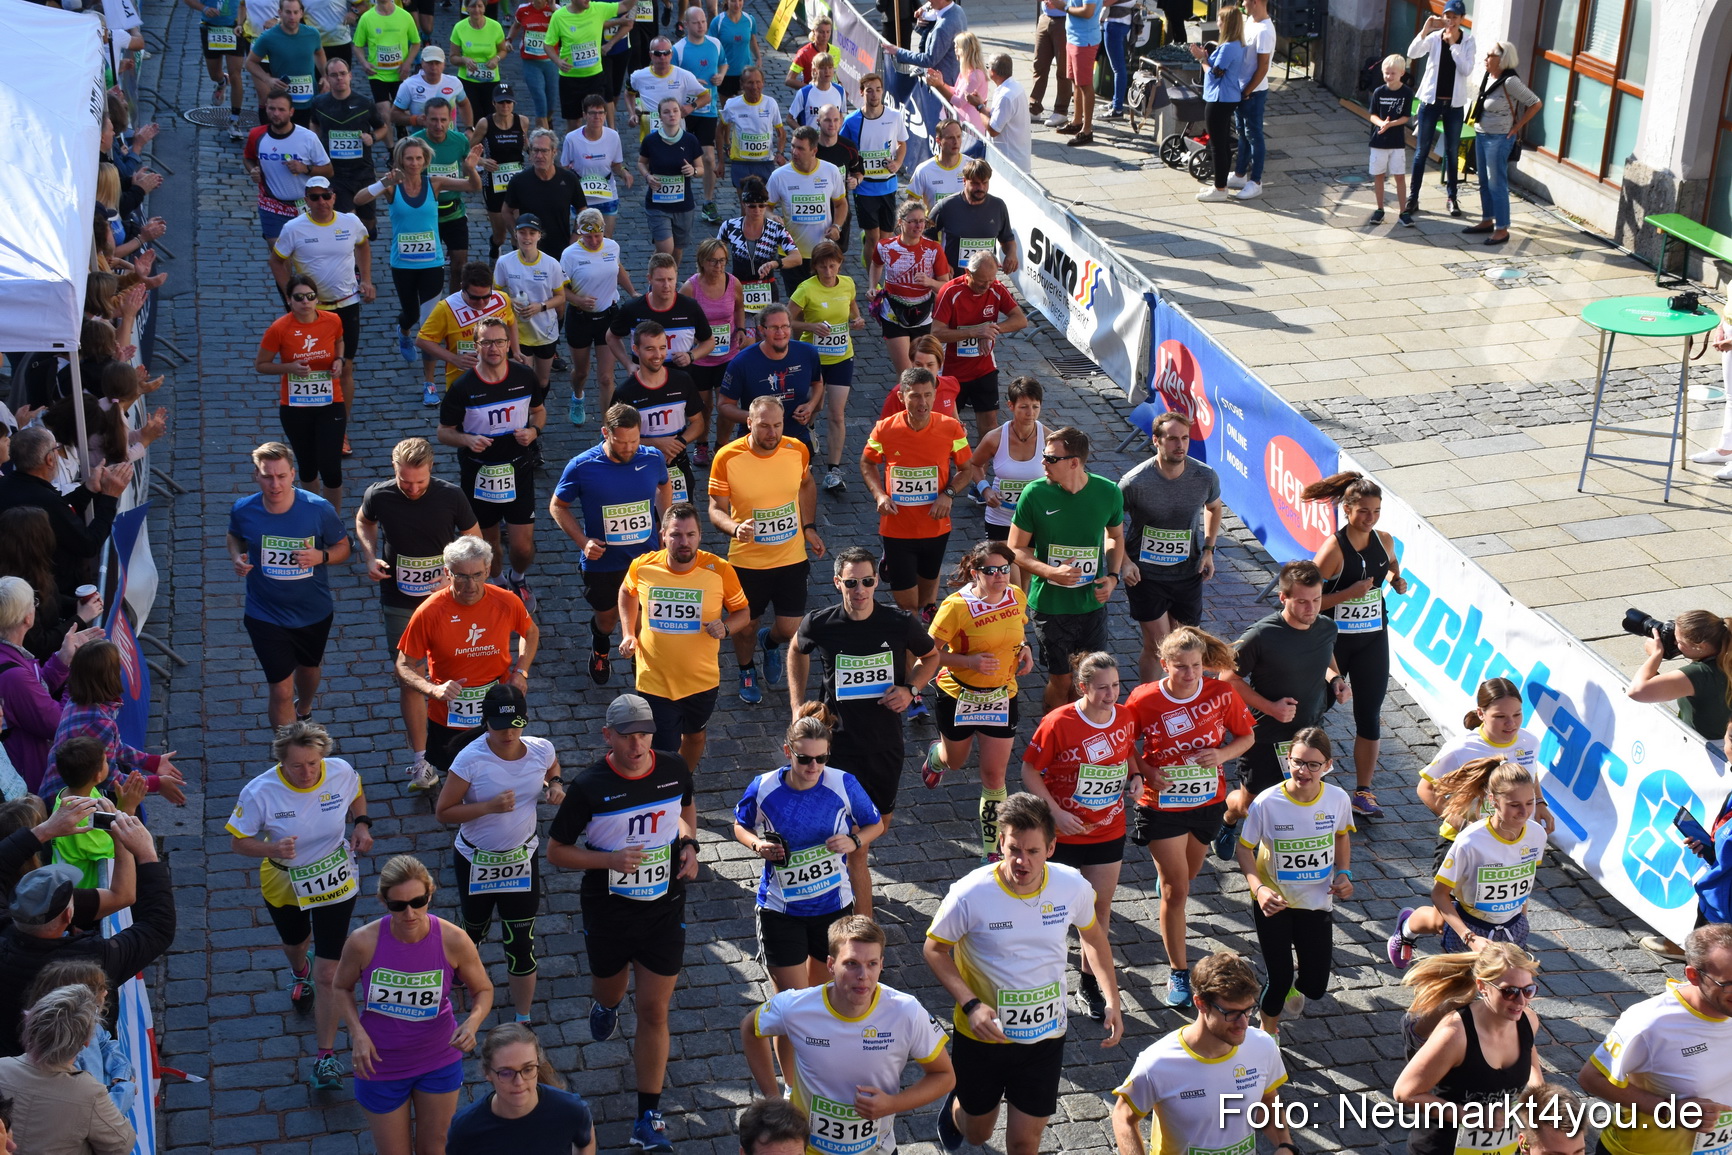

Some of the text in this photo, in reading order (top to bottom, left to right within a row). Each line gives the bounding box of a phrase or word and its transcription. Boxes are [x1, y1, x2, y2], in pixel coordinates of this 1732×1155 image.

[212, 35, 233, 43] 1353
[379, 51, 400, 60] 5059
[575, 51, 597, 60] 2233
[333, 139, 360, 149] 2522
[744, 142, 767, 151] 1005
[583, 182, 608, 191] 1022
[656, 184, 681, 194] 2072
[793, 194, 823, 202] BOCK
[795, 204, 823, 214] 2290
[402, 242, 432, 253] 2722
[963, 239, 994, 247] BOCK
[1028, 227, 1078, 297] swn
[817, 334, 847, 346] 2208
[817, 346, 846, 354] GERLINDE
[294, 383, 328, 395] 2134
[1156, 345, 1210, 427] Hervis
[296, 396, 327, 404] MELANIE
[1221, 397, 1244, 421] STORE
[1226, 423, 1248, 451] ONLINE
[480, 464, 513, 475] BOCK
[1226, 450, 1248, 479] MOBILE
[894, 467, 933, 478] BOCK
[480, 476, 511, 490] 2115
[896, 480, 932, 492] 2541
[482, 491, 509, 499] ROBERT
[899, 494, 929, 502] RONALD
[607, 503, 645, 516] BOCK
[758, 505, 794, 521] BOCK
[610, 515, 647, 532] 2163
[759, 517, 794, 533] 2162
[760, 531, 793, 542] ANDREAS
[1147, 528, 1187, 539] BOCK
[1147, 539, 1184, 553] 2295
[1052, 547, 1094, 558] BOCK
[1150, 554, 1178, 562] MARTIN
[267, 567, 309, 575] CHRISTIAN
[402, 568, 441, 583] 2280
[652, 589, 698, 600] BOCK
[653, 603, 696, 619] 2159
[1341, 604, 1378, 619] 2425
[974, 607, 1020, 628] MAX BÖGL
[658, 622, 689, 630] TOBIAS
[1348, 621, 1372, 629] MARIA
[455, 644, 495, 656] funrunners
[467, 648, 500, 658] neumarkt
[842, 656, 887, 668] BOCK
[842, 669, 887, 685] 2838
[962, 701, 1003, 714] 2382
[1083, 766, 1126, 778] BOCK
[1165, 766, 1212, 778] BOCK
[1081, 780, 1122, 795] 2263
[1167, 781, 1211, 794] 2261
[319, 793, 331, 803] 20
[1081, 795, 1114, 805] KAROLIN
[1169, 795, 1207, 803] CLAUDIA
[1279, 837, 1331, 851] BOCK
[476, 852, 525, 865] BOCK
[1283, 851, 1330, 868] 2641
[291, 850, 346, 881] BOCK
[478, 864, 524, 880] 2307
[785, 860, 833, 885] 2483
[1296, 871, 1321, 879] JULE
[1484, 866, 1534, 881] BOCK
[302, 866, 348, 894] 1146
[499, 879, 519, 887] ANH
[628, 887, 655, 896] JENS
[796, 881, 830, 895] JASMIN
[1484, 879, 1530, 900] 2519
[309, 886, 350, 903] SOLWEIG
[1042, 903, 1053, 914] 20
[1492, 901, 1521, 912] CARLA
[1042, 918, 1066, 926] Stadtlauf
[377, 970, 435, 986] BOCK
[376, 988, 434, 1006] 2118
[1003, 985, 1056, 1003] BOCK
[381, 1004, 426, 1017] CARMEN
[1005, 1002, 1054, 1026] 2461
[863, 1028, 877, 1038] 20
[1004, 1021, 1055, 1037] CHRISTOPH
[1603, 1035, 1622, 1059] 20
[1234, 1066, 1247, 1078] 20
[817, 1117, 873, 1140] 2318
[815, 1138, 872, 1151] ALEXANDER
